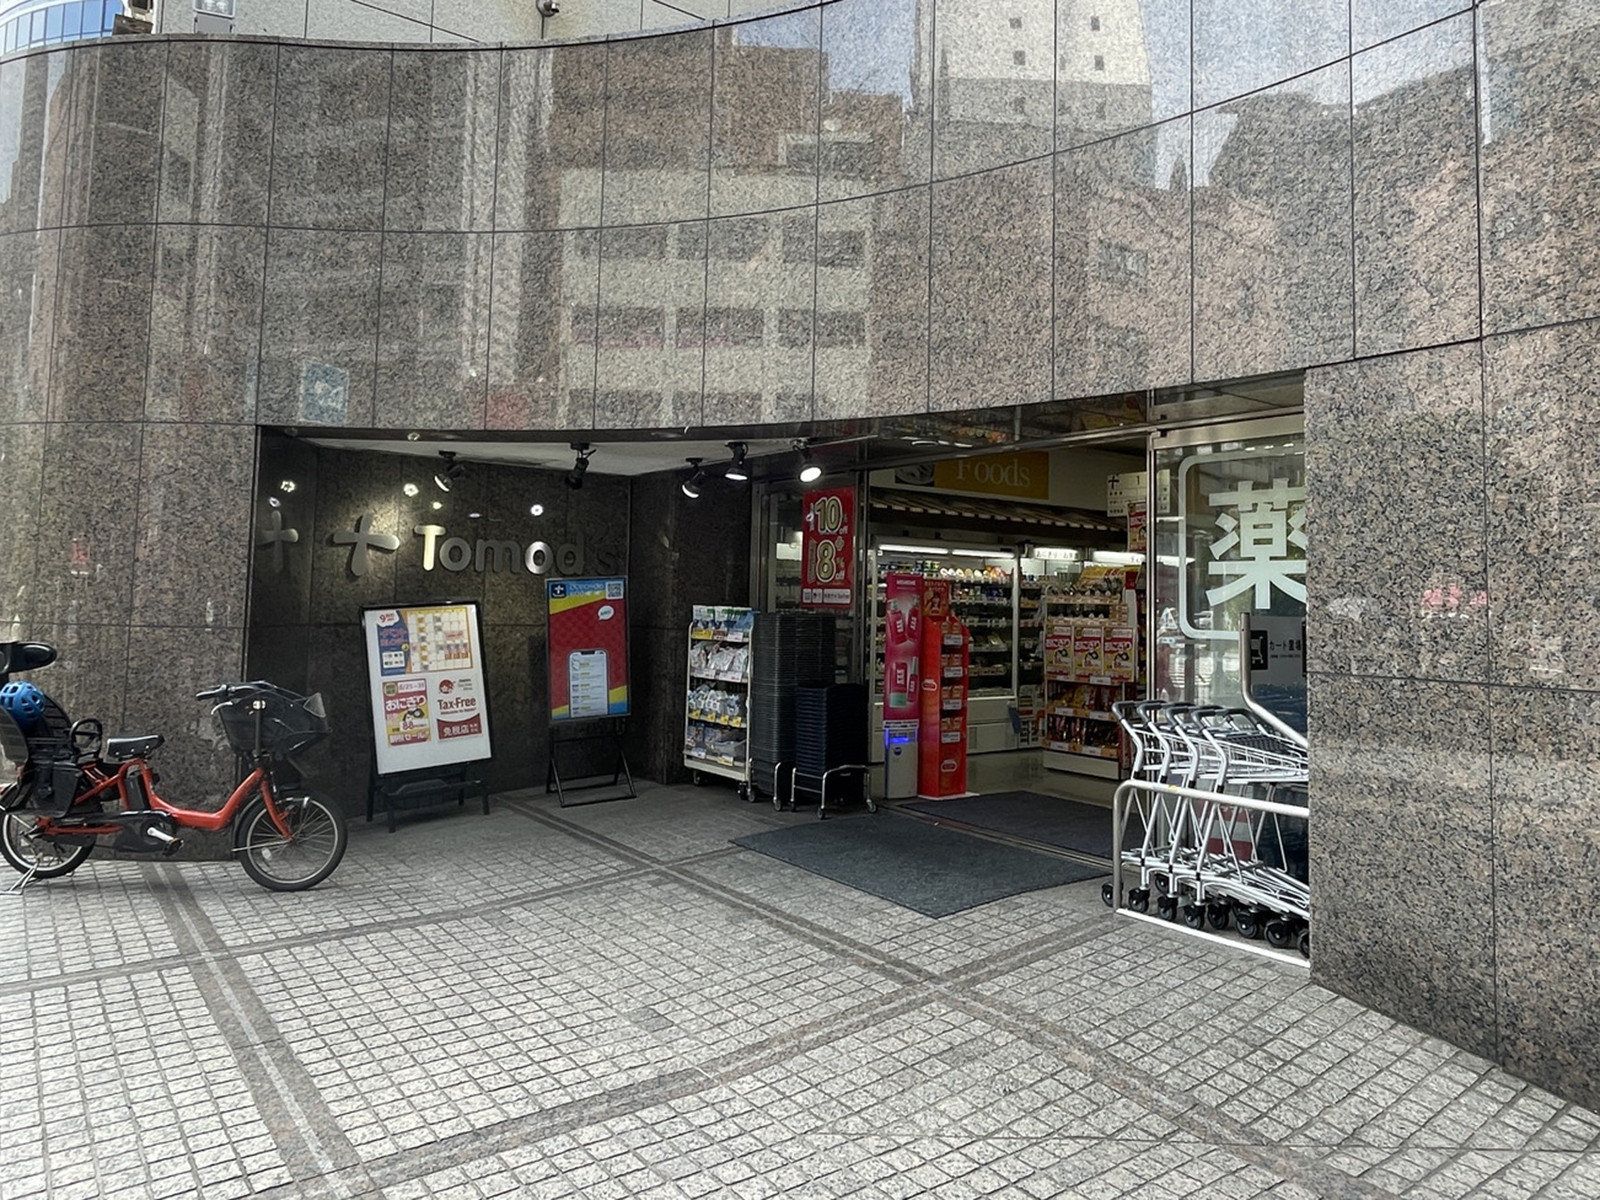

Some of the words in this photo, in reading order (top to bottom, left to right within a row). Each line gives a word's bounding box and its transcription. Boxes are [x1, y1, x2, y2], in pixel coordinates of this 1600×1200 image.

[956, 459, 1031, 487] Foods
[815, 496, 842, 533] 10
[815, 539, 836, 582] 8
[1206, 478, 1306, 609] 薬
[438, 697, 476, 710] Tax-Free
